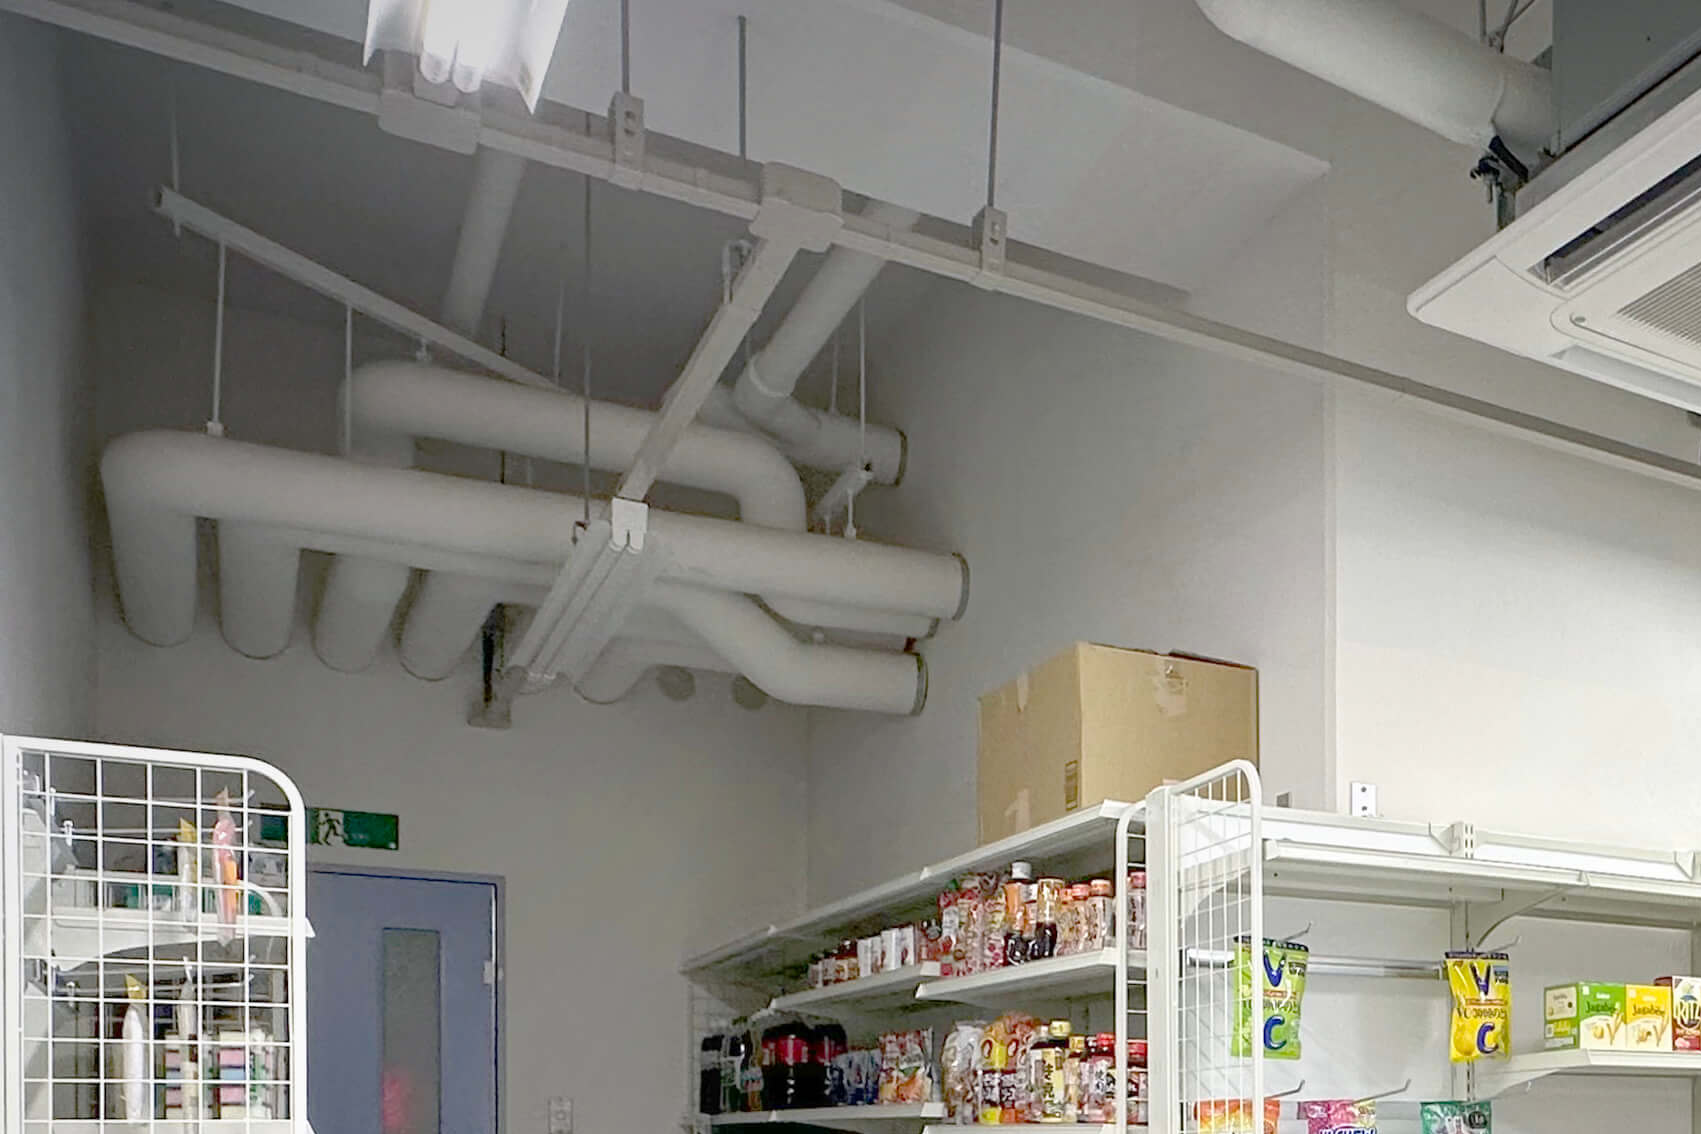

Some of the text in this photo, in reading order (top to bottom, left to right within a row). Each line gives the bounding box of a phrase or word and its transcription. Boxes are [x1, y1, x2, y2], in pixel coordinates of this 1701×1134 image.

[1469, 962, 1492, 996] V
[1675, 1000, 1701, 1024] RITZ
[1263, 1015, 1286, 1050] C
[1476, 1022, 1499, 1054] C
